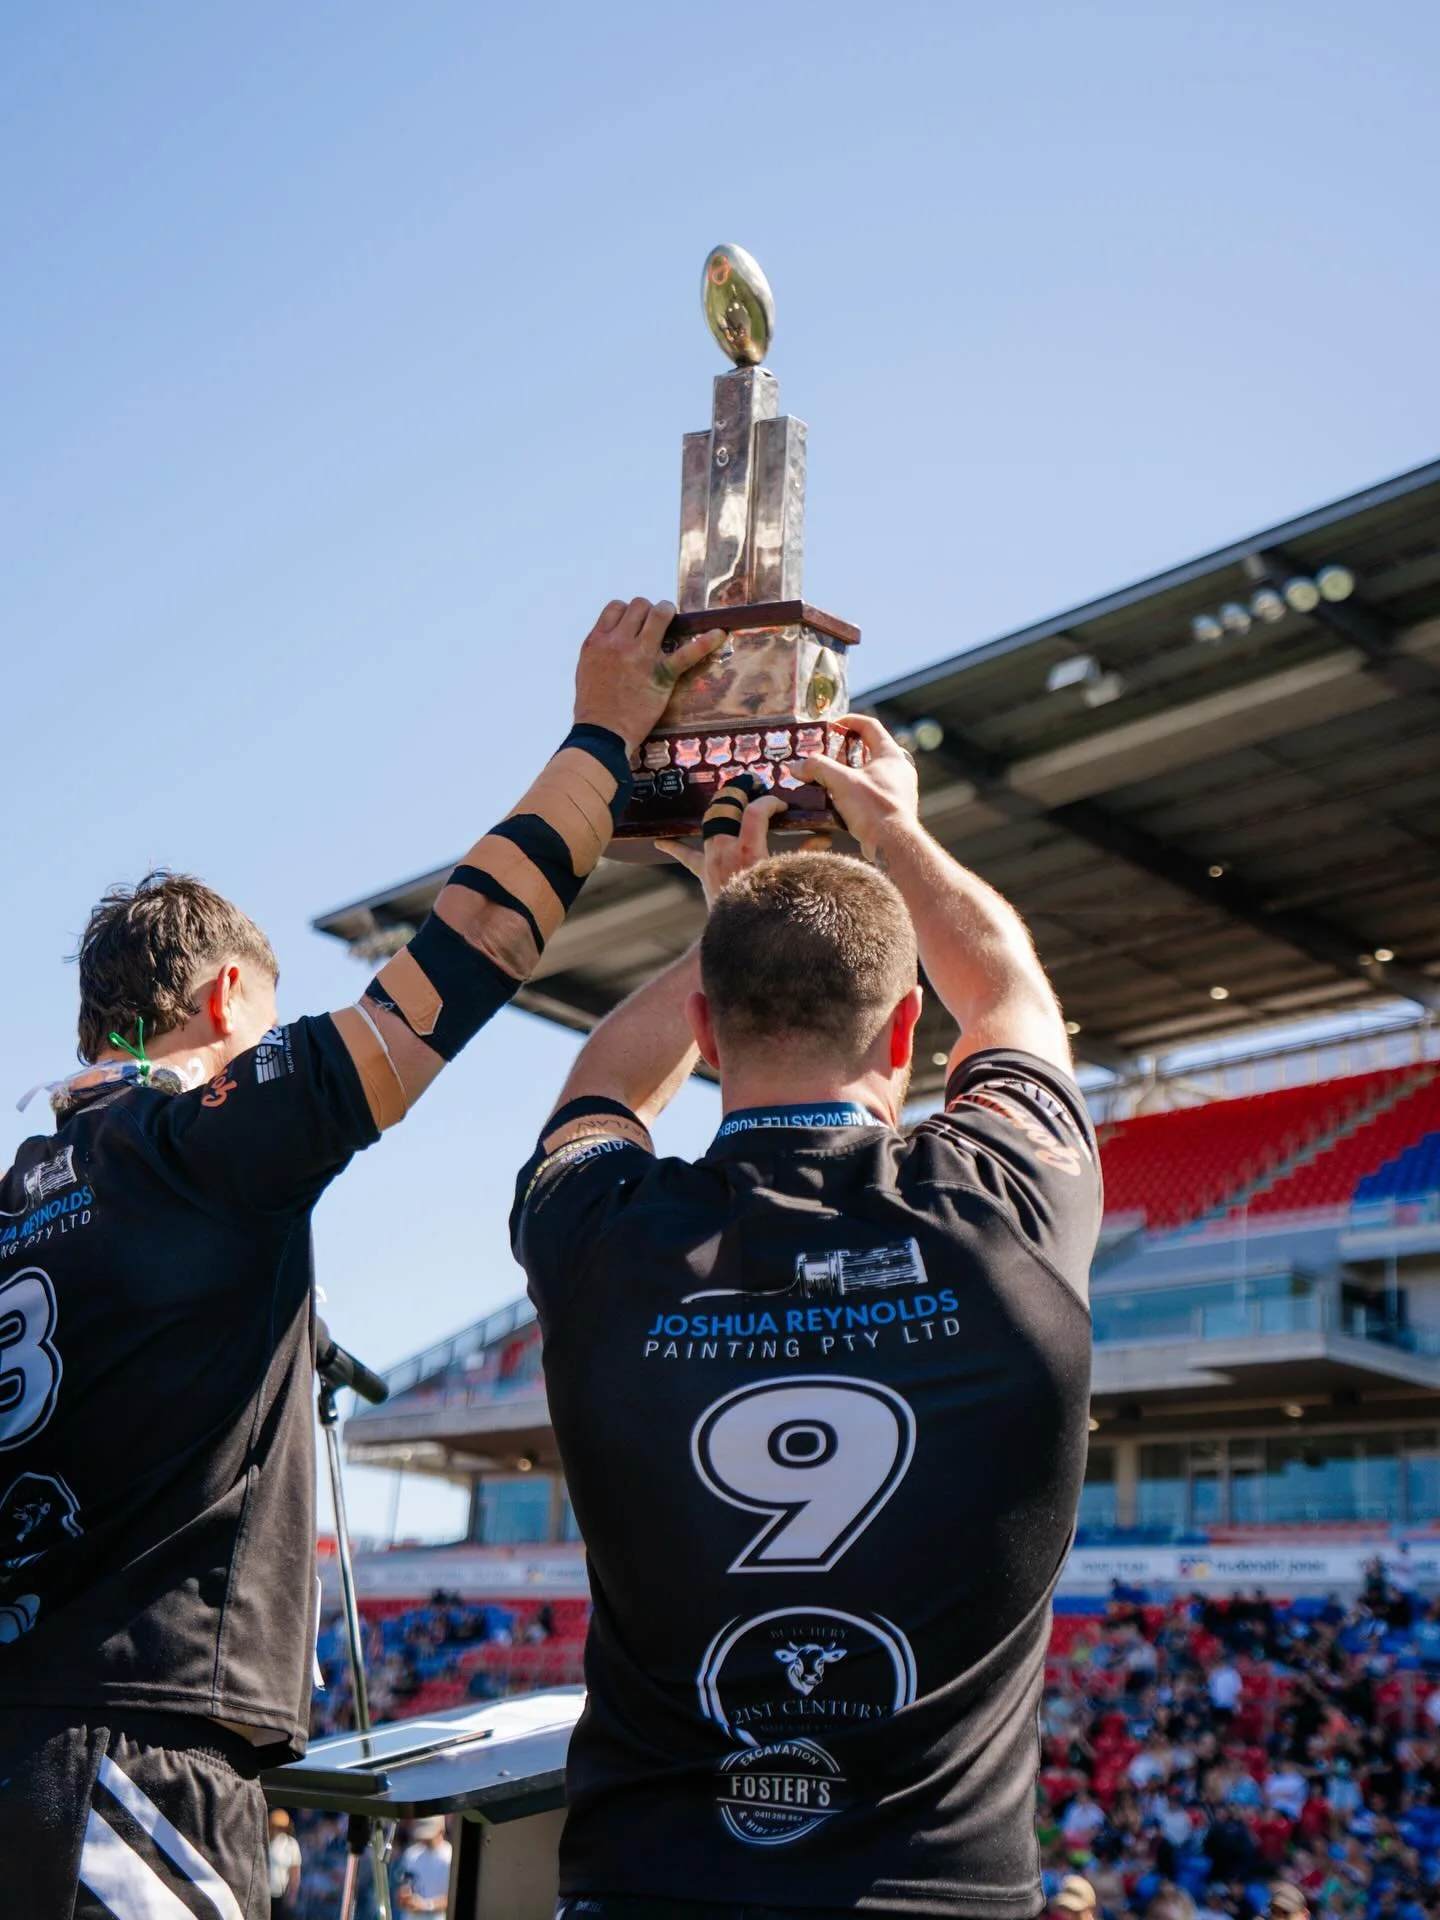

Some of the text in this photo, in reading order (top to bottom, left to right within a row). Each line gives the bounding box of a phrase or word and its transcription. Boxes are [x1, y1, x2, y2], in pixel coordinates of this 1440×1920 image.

[763, 1111, 862, 1128] NEWCASTLE
[20, 1185, 93, 1237] REYNOLDS
[24, 1225, 53, 1248] PTY
[60, 1210, 91, 1233] LTD
[648, 1289, 960, 1337] JOSHUA REYNOLDS
[644, 1317, 961, 1358] PAINTING PTY LTD
[690, 1374, 917, 1574] 9
[731, 1699, 889, 1726] 21ST CENTURY
[739, 1743, 820, 1768] EXCAVATION
[731, 1775, 831, 1807] FOSTER'S
